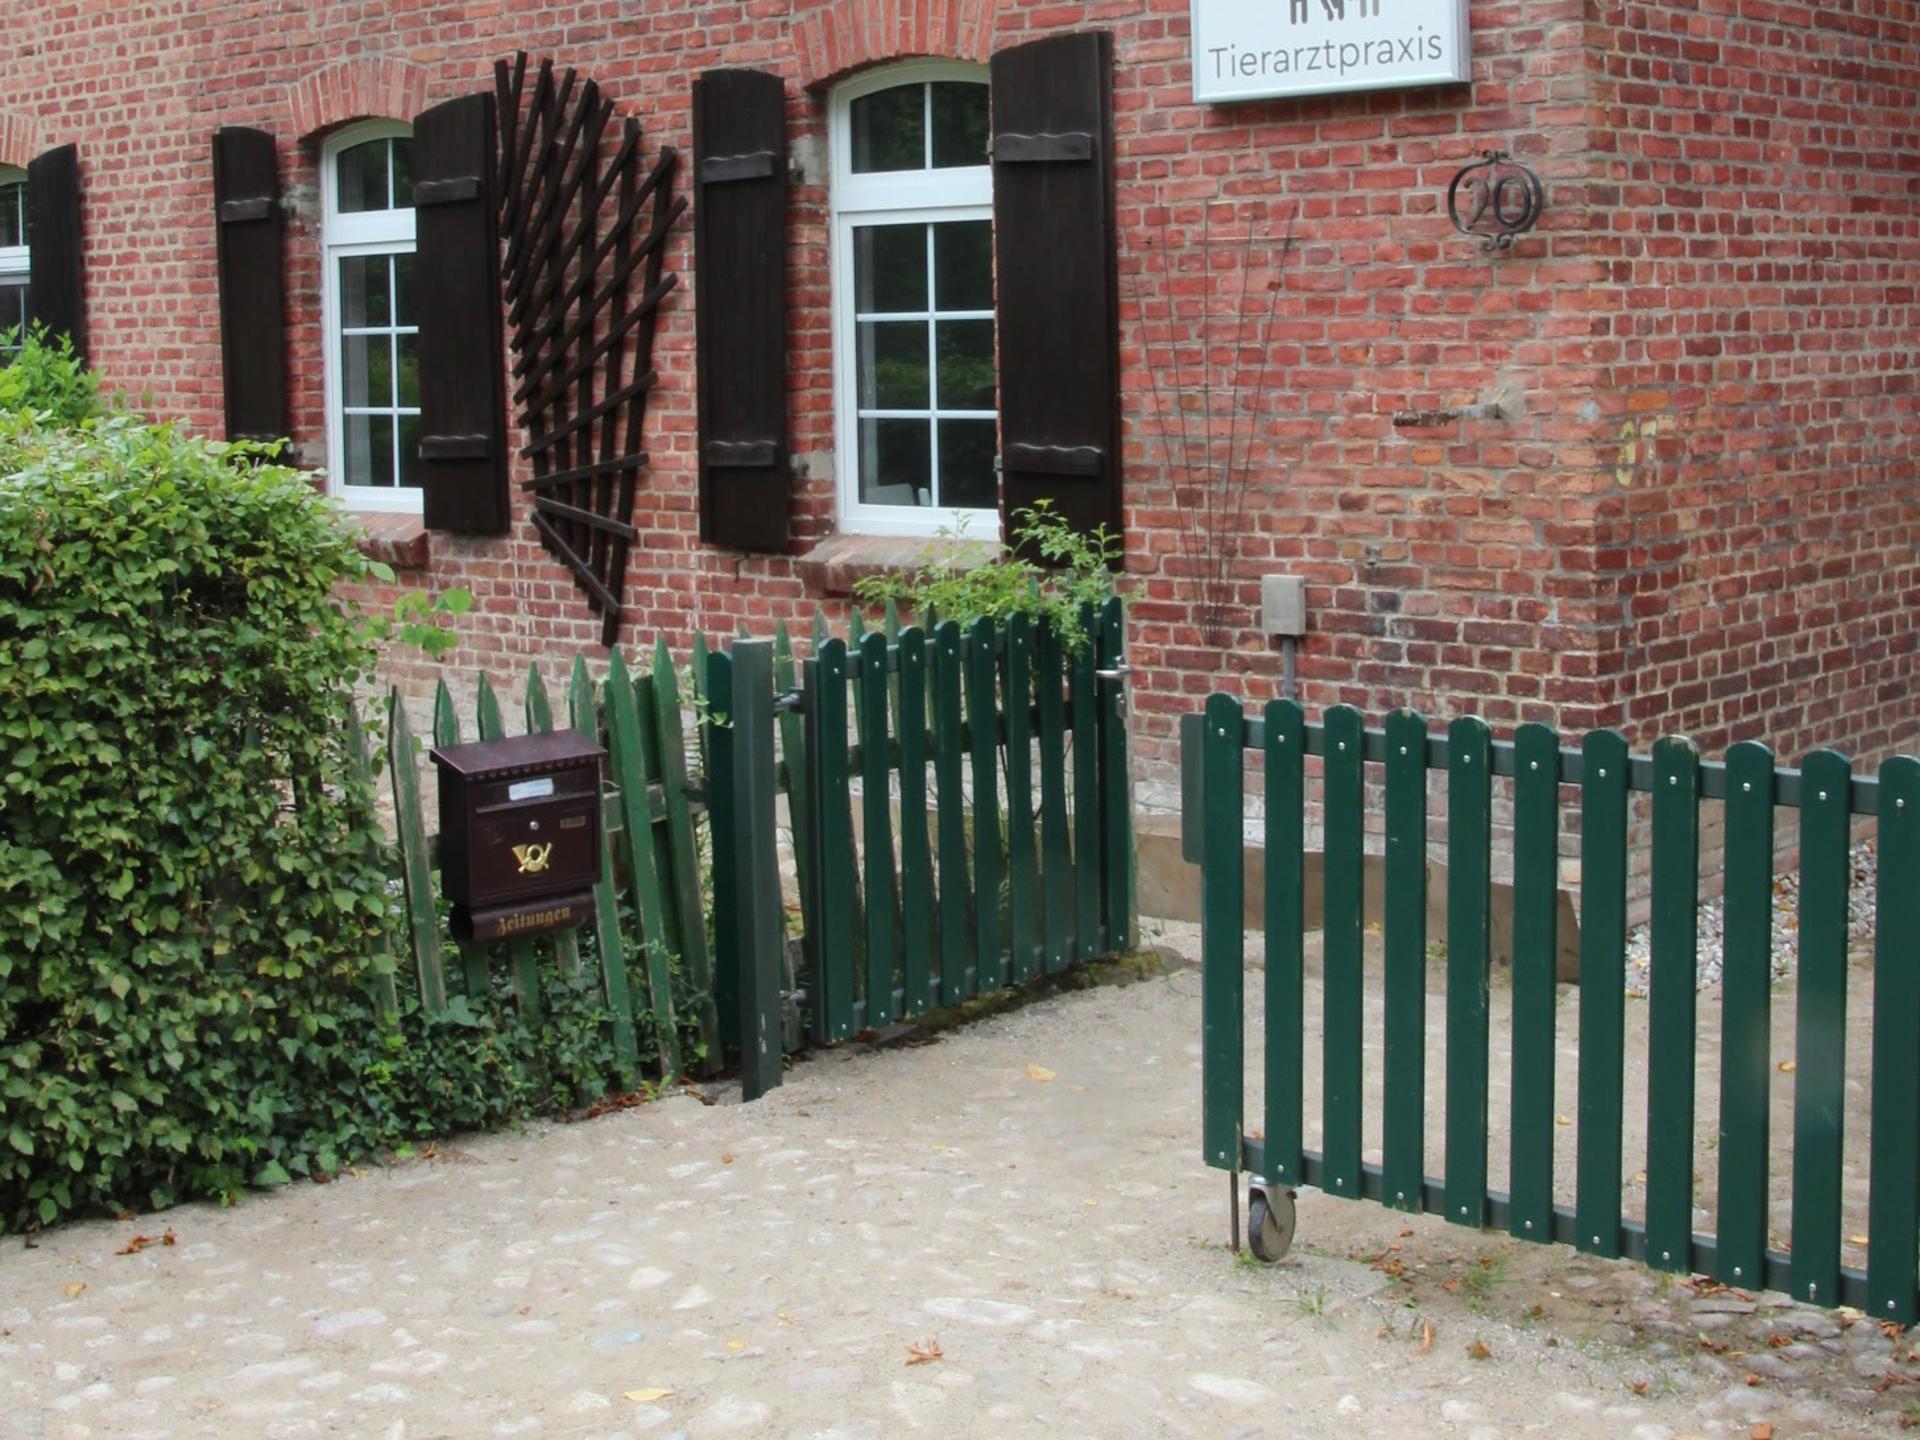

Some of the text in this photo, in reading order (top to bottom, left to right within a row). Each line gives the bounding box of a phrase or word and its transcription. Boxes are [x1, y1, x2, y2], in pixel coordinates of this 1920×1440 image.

[1208, 25, 1442, 78] Tierarztpraxis
[1463, 173, 1531, 230] 20
[496, 906, 571, 937] Zeitungen
